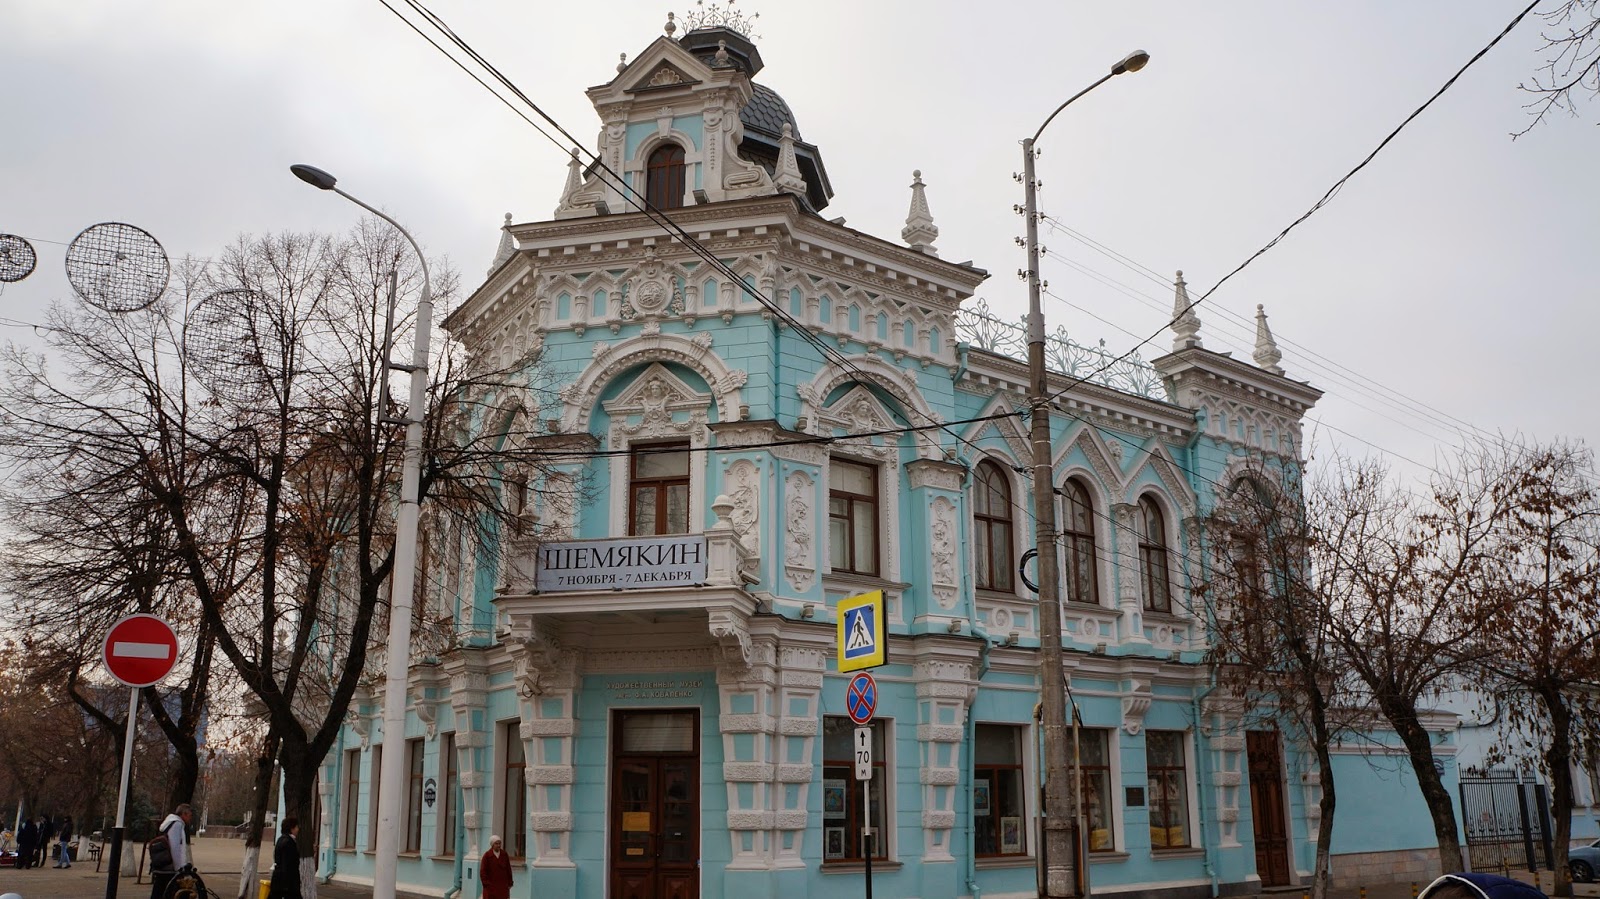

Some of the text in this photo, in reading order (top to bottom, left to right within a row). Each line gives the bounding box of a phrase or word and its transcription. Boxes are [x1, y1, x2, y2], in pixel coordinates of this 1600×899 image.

[544, 542, 702, 570] ШЕМЯКИН
[558, 576, 564, 585] 7
[567, 574, 616, 585] НОЯБРЯ
[626, 573, 632, 583] 7
[634, 571, 692, 583] ДЕКАБРЯ
[857, 751, 869, 764] 70
